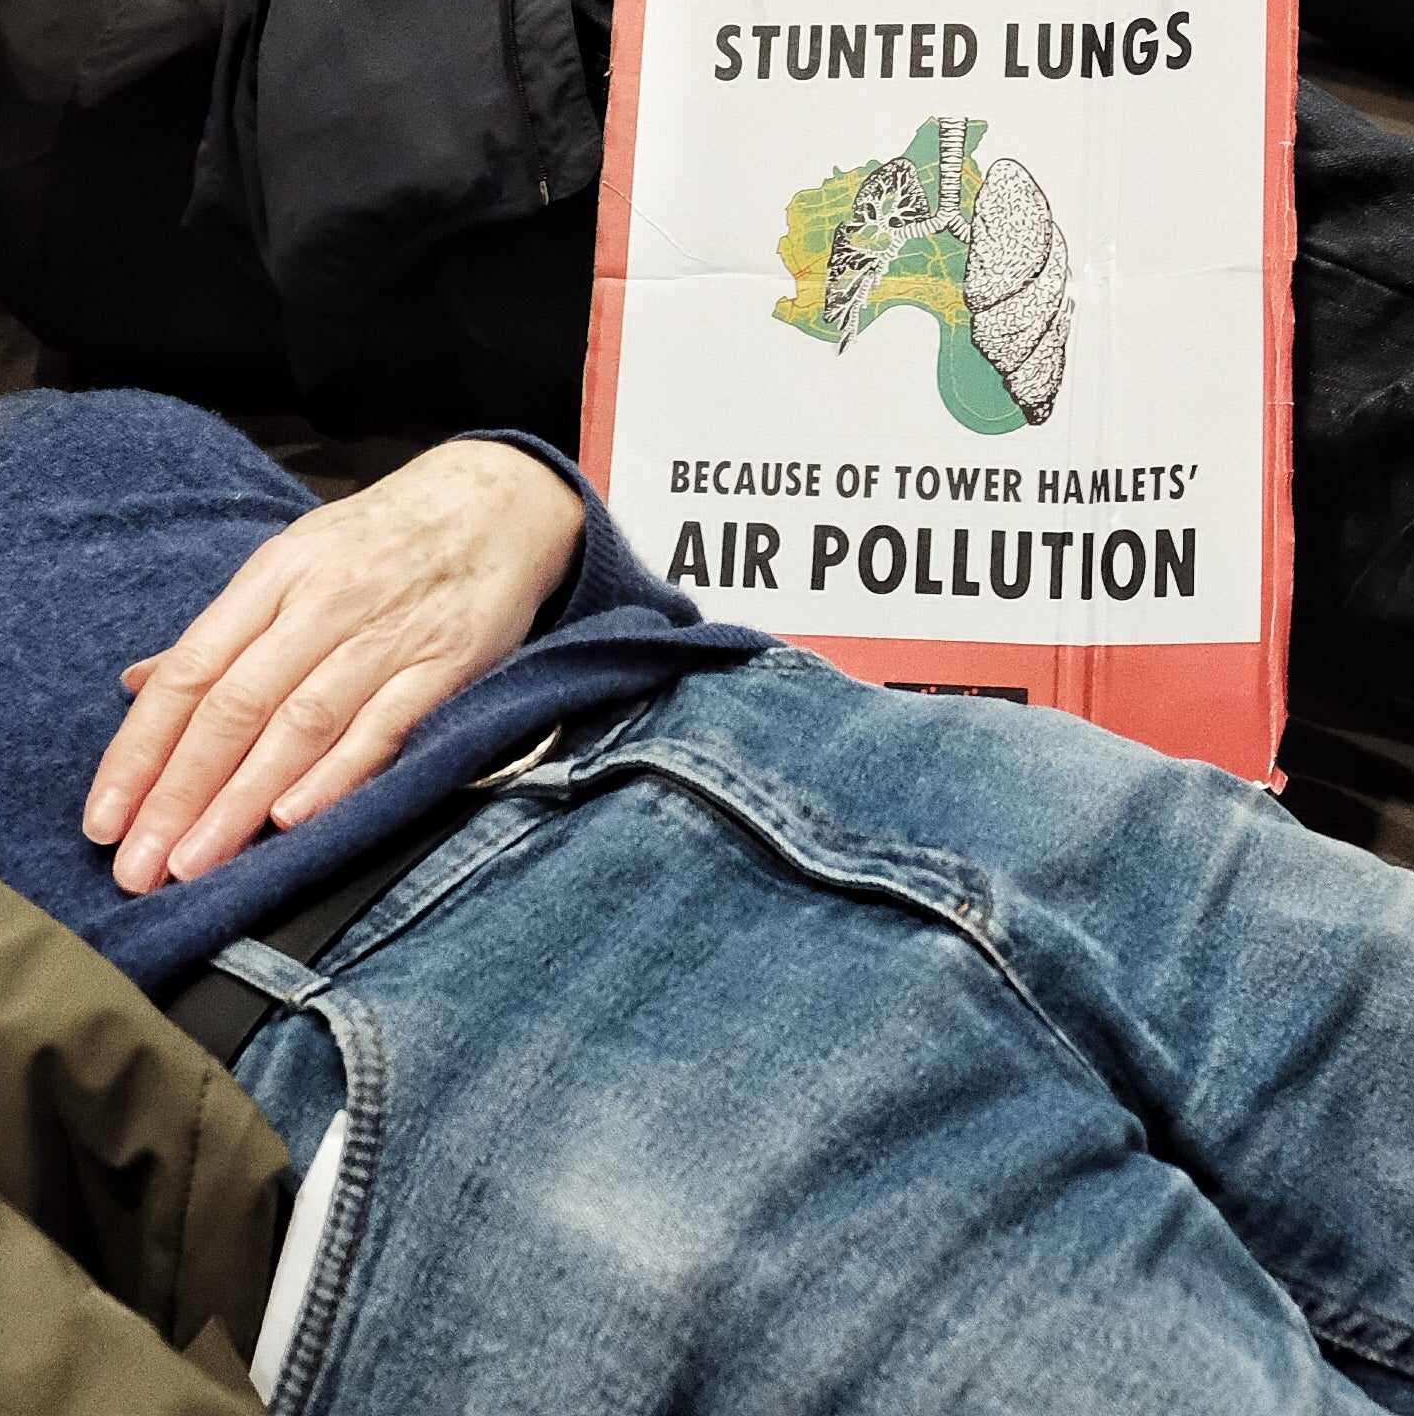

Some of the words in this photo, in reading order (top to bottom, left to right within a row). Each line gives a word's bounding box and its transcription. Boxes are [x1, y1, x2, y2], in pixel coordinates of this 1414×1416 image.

[715, 24, 977, 81] STUNTED
[1005, 12, 1191, 79] LUNGS
[671, 461, 820, 496] BECAUSE
[837, 464, 879, 498] OF
[896, 466, 1021, 502] TOWER
[1039, 465, 1197, 504] HAMLETS'
[666, 520, 780, 590] AIR
[811, 525, 1195, 600] POLLUTION
